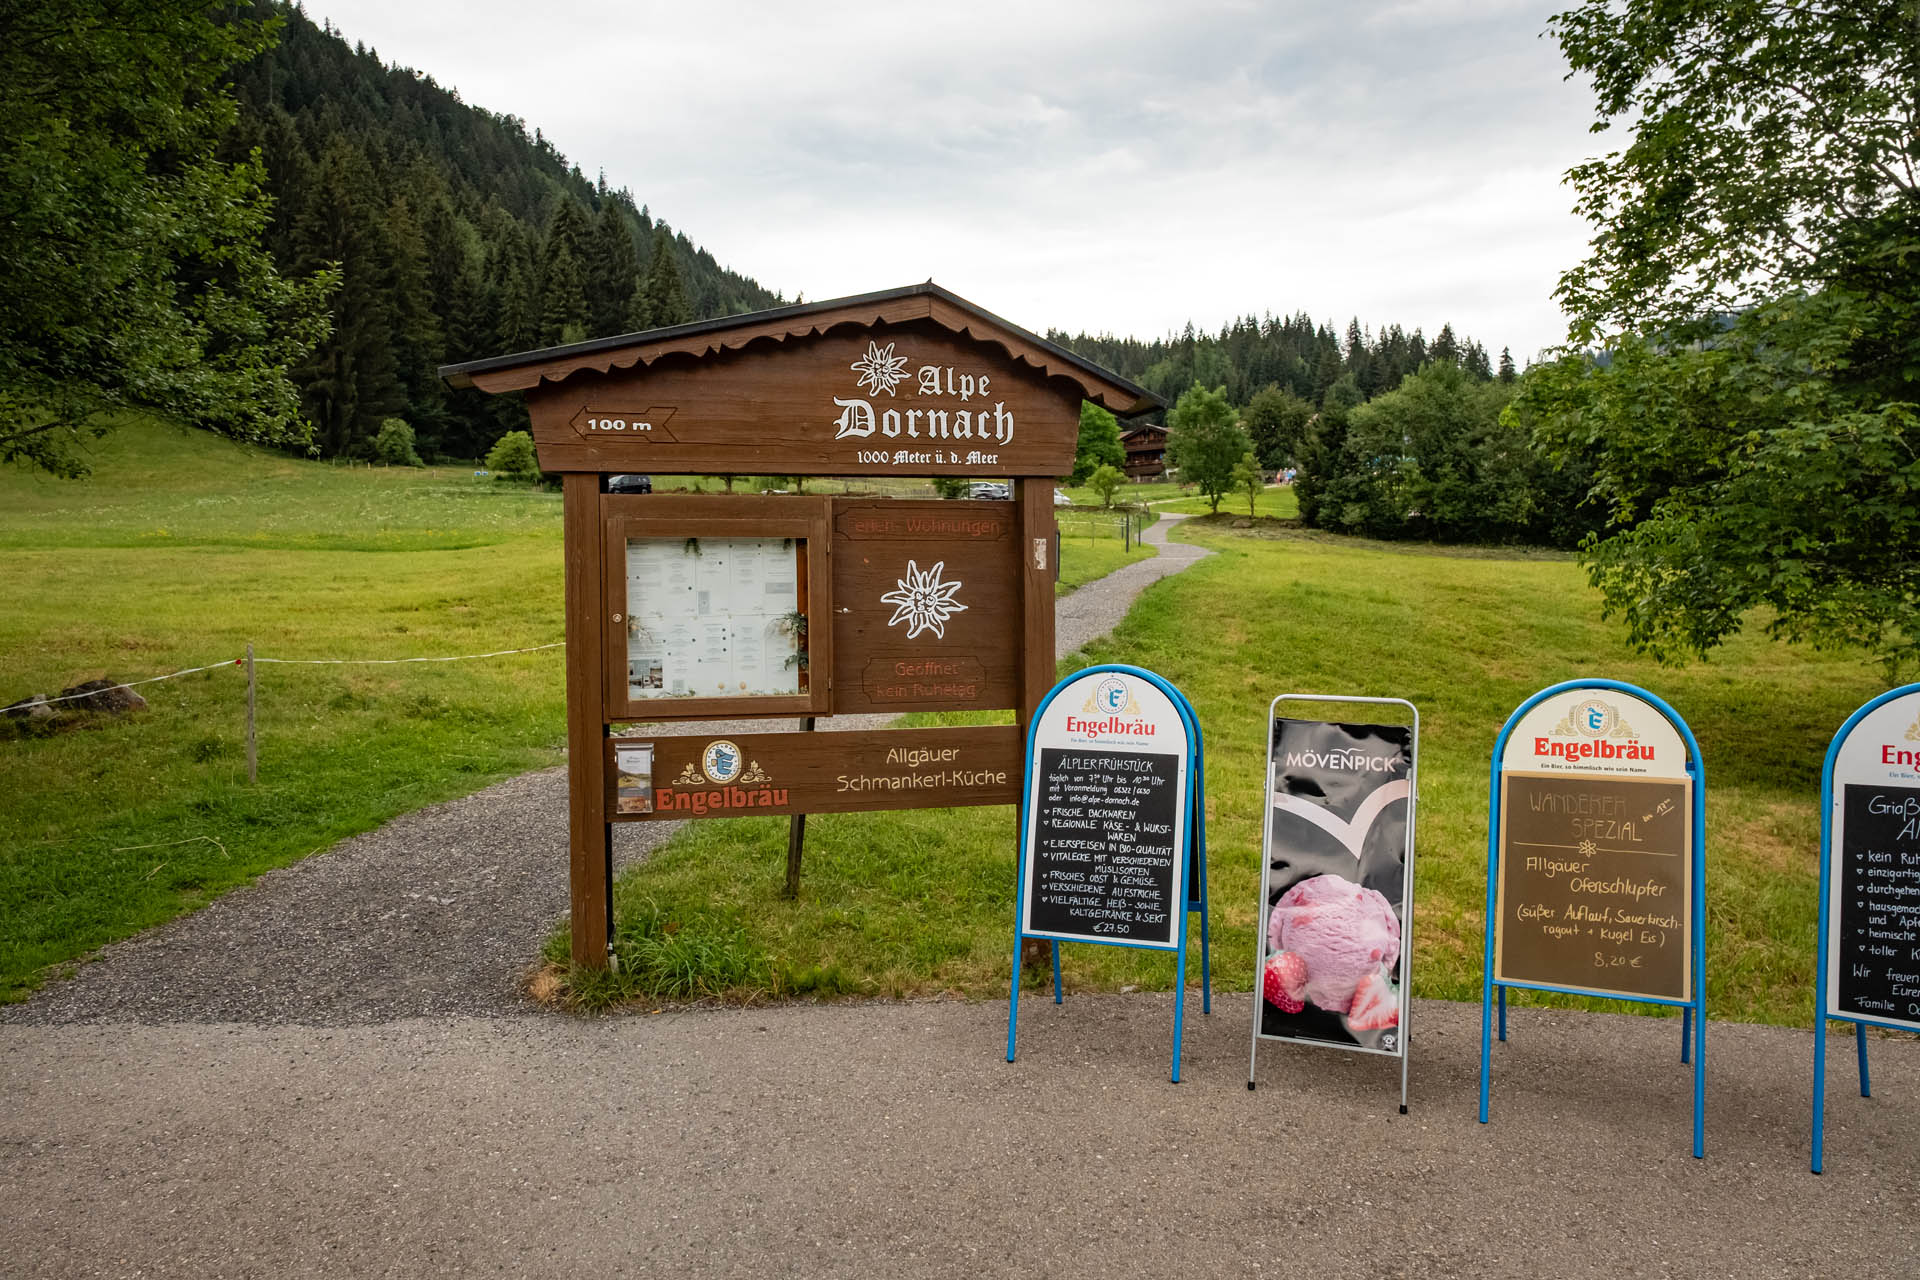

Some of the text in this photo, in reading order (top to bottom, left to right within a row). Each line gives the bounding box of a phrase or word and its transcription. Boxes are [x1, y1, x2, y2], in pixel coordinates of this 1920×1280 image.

[917, 365, 991, 402] Alpe
[588, 419, 652, 430] 100 m
[832, 396, 1014, 446] Dornach
[857, 450, 999, 465] 1000 Meter ü. d. Meer
[906, 518, 999, 536] Wohnungen
[912, 683, 977, 698] Ruhetag
[1066, 716, 1156, 739] Engelbräu
[886, 747, 960, 767] Allgäuer
[1534, 737, 1655, 762] Engelbräu
[1286, 749, 1397, 773] MÖVENPICK
[836, 769, 1007, 792] Schmankerl-Küche
[1048, 773, 1069, 785] täglich
[1102, 775, 1114, 784] Uhr
[1116, 775, 1127, 784] bis
[1151, 776, 1165, 786] Uhr
[1048, 794, 1063, 802] oder
[1049, 785, 1060, 793] mit
[1064, 784, 1108, 797] Voranmeldung
[655, 784, 789, 815] Engelbräu
[1052, 807, 1136, 820] FRISCHE BACKWAREN
[1051, 819, 1097, 829] REGIONALE
[1134, 822, 1141, 832] &
[1143, 822, 1172, 834] WURST-
[1571, 818, 1643, 842] SPEZIAL
[1107, 831, 1137, 842] WAREN
[1050, 839, 1173, 856] EIERSPEISEN IN BIO-QUALITÄT
[1050, 852, 1172, 867] VITALECKE MIT VERSCHIEDENEN
[1868, 850, 1892, 864] kein
[1094, 864, 1150, 876] MÜSLISORTEN
[1526, 857, 1592, 878] Allgäuer
[1049, 870, 1085, 882] FRISCHES
[1089, 874, 1109, 883] OBST
[1119, 875, 1158, 887] GEMÜSE
[1048, 882, 1163, 901] VERSCHIEDENE AUFSTRICHE
[1570, 877, 1667, 902] Ofenschlupfer
[1049, 895, 1102, 907] VIELFÄLTIGE
[1134, 901, 1161, 911] SOWIE
[1069, 908, 1133, 922] KALTGETRÄNKE
[1142, 913, 1167, 923] SEKT
[1868, 915, 1887, 925] und
[1543, 924, 1580, 939] ragout
[1599, 928, 1633, 945] Kugel
[1868, 928, 1916, 941] heimische
[1868, 944, 1898, 957] toller
[1853, 963, 1919, 983] Wir freuen
[1854, 996, 1895, 1011] Familie
